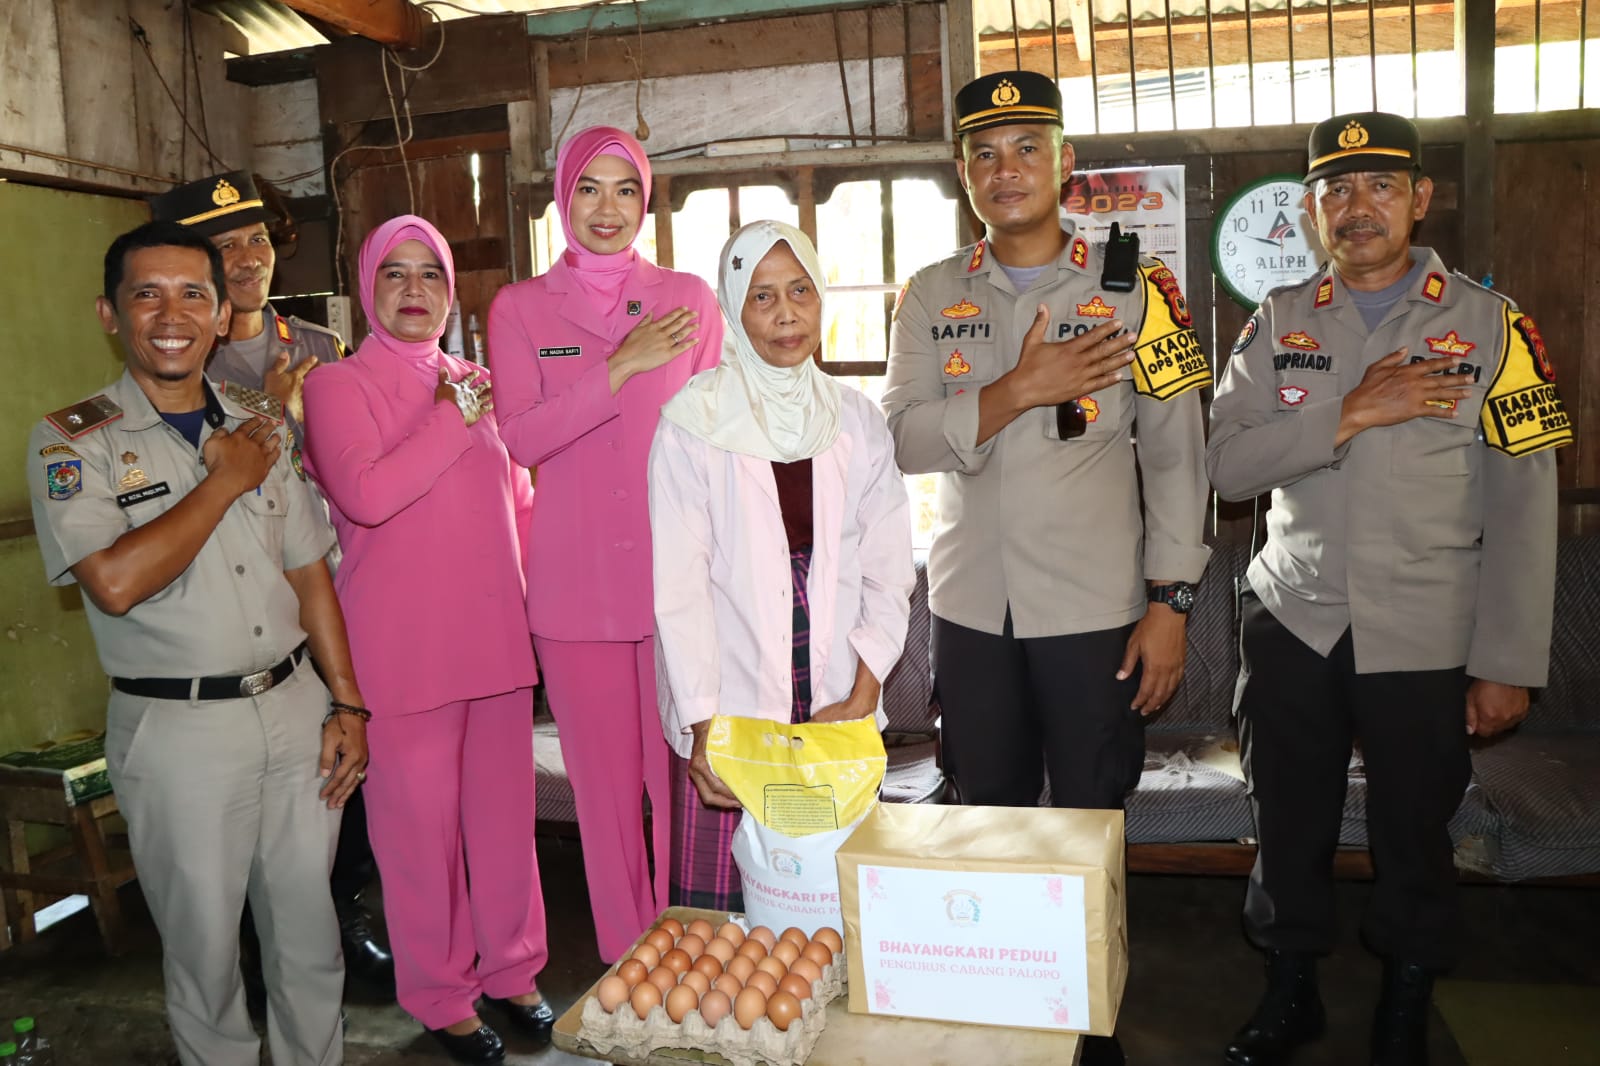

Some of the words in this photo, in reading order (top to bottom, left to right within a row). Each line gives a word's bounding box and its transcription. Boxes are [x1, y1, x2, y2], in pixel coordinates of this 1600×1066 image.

[1066, 191, 1163, 214] 2023
[1273, 191, 1289, 206] 12
[1251, 199, 1264, 214] 11
[1232, 217, 1248, 233] 10
[1226, 241, 1237, 256] 9
[1256, 255, 1307, 270] ALIPH
[1235, 264, 1246, 279] 8
[1255, 280, 1264, 295] 7
[1148, 356, 1174, 375] OPS
[1506, 410, 1536, 428] OPS
[820, 892, 838, 903] PE
[879, 940, 994, 960] BHAYANGKARI
[999, 948, 1057, 963] PEDULI
[880, 958, 946, 973] PENGURUS
[950, 964, 1005, 977] CABANG
[1008, 967, 1060, 980] PALOPO
